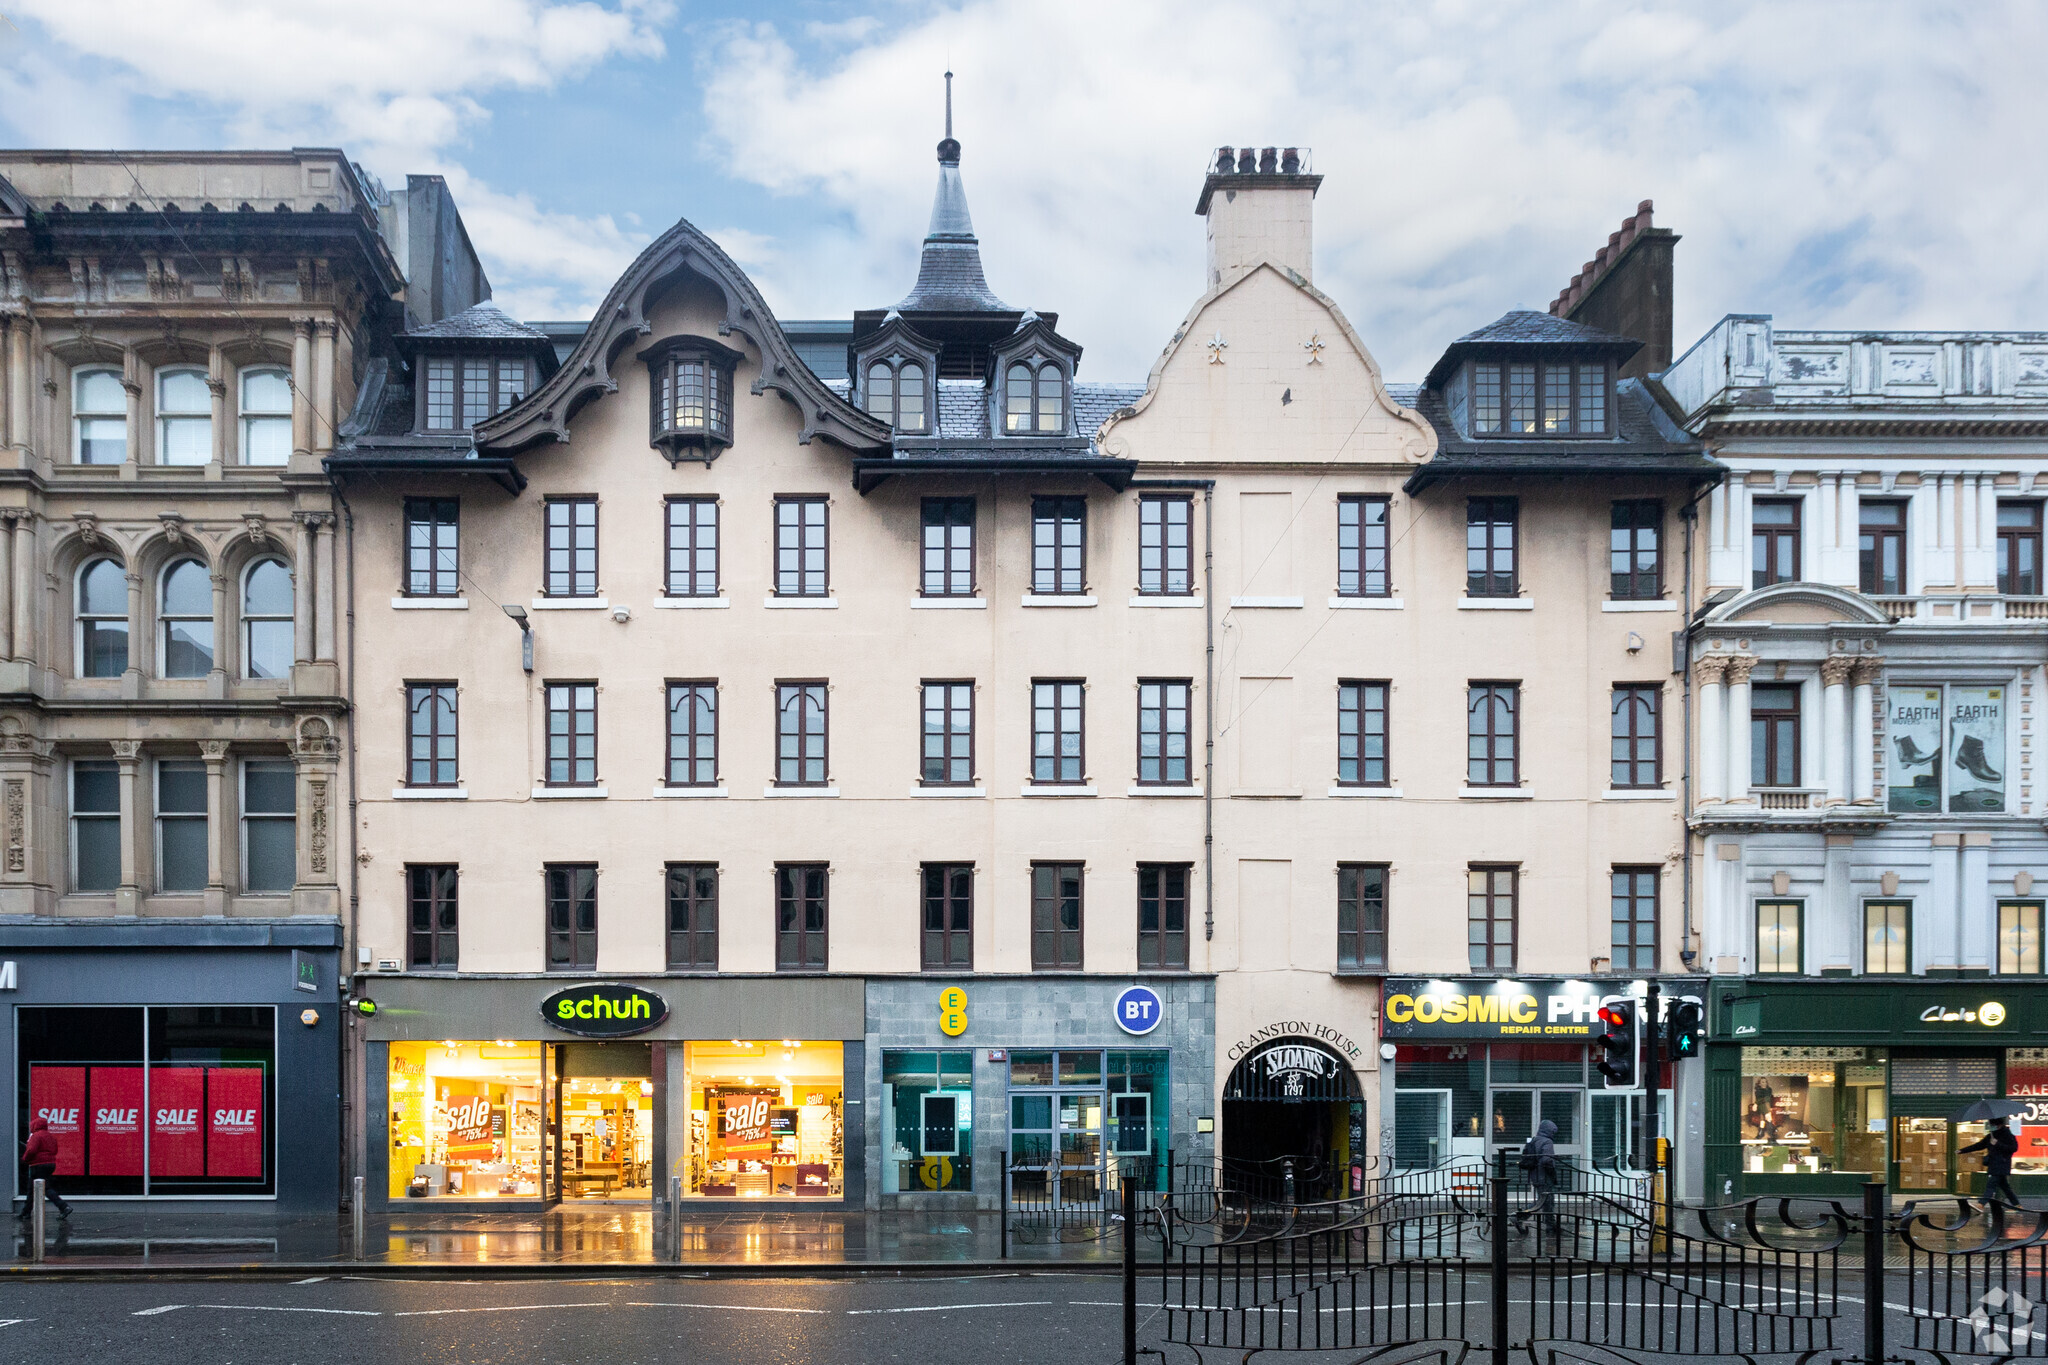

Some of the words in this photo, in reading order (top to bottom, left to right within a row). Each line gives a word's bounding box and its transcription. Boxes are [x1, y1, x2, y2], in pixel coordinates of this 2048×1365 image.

[1898, 706, 1939, 720] EARTH
[1956, 705, 1998, 718] EARTH
[557, 994, 650, 1019] schuh
[1125, 1001, 1152, 1019] BT
[1386, 994, 1538, 1023] COSMIC
[1920, 1005, 1977, 1022] Clarks
[1500, 1025, 1542, 1034] REPAIR
[1544, 1025, 1589, 1034] CENTRE
[1227, 1020, 1311, 1061] CRANSTON
[1314, 1024, 1362, 1061] HOUSE
[1266, 1048, 1324, 1075] SLOANS
[1283, 1085, 1304, 1096] 1797
[2012, 1084, 2048, 1095] SALE
[806, 1093, 824, 1105] sale
[38, 1108, 79, 1124] SALE
[96, 1108, 138, 1124] SALE
[155, 1108, 198, 1125] SALE
[213, 1109, 256, 1125] SALE
[447, 1096, 490, 1132] sale
[726, 1096, 769, 1132] sale
[466, 1127, 482, 1141] 75%
[745, 1127, 760, 1141] 75%
